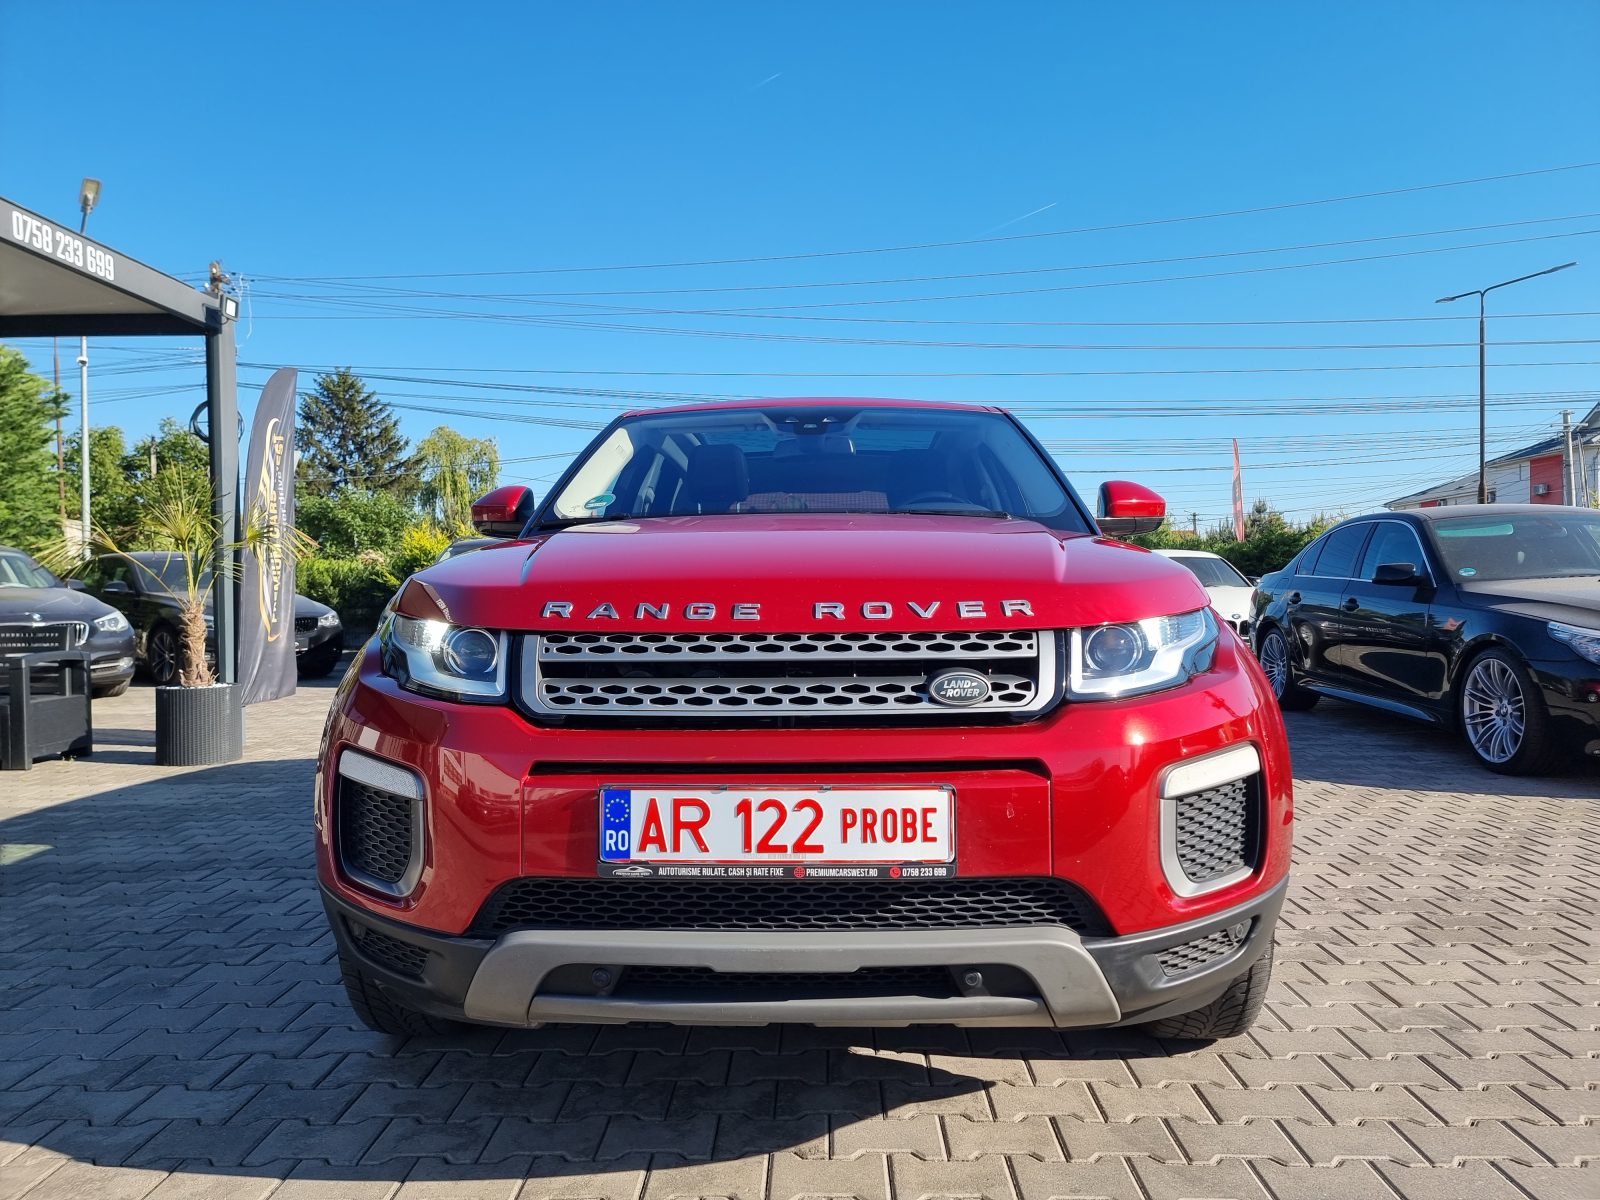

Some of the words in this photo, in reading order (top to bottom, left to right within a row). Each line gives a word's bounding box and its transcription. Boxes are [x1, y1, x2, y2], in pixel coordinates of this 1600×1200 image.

[11, 211, 53, 254] 0758
[56, 231, 83, 268] 233
[86, 245, 115, 281] 699
[272, 433, 285, 482] EST
[542, 602, 761, 620] RANGE
[813, 599, 1036, 620] ROVER
[943, 680, 971, 689] LAND
[945, 688, 980, 698] ROVER
[605, 830, 629, 851] RO
[637, 797, 711, 853] AR
[735, 798, 824, 854] 122
[840, 807, 937, 844] PROBE
[658, 867, 701, 876] AUTOTURISME
[702, 867, 727, 877] RULATE,
[728, 867, 745, 877] CASH
[753, 867, 769, 877] RATE
[770, 867, 784, 876] FIXE
[806, 868, 878, 877] PREMIUMCARSWEST.RO
[902, 867, 919, 877] 0758
[920, 867, 933, 877] 233
[934, 867, 947, 876] 699
